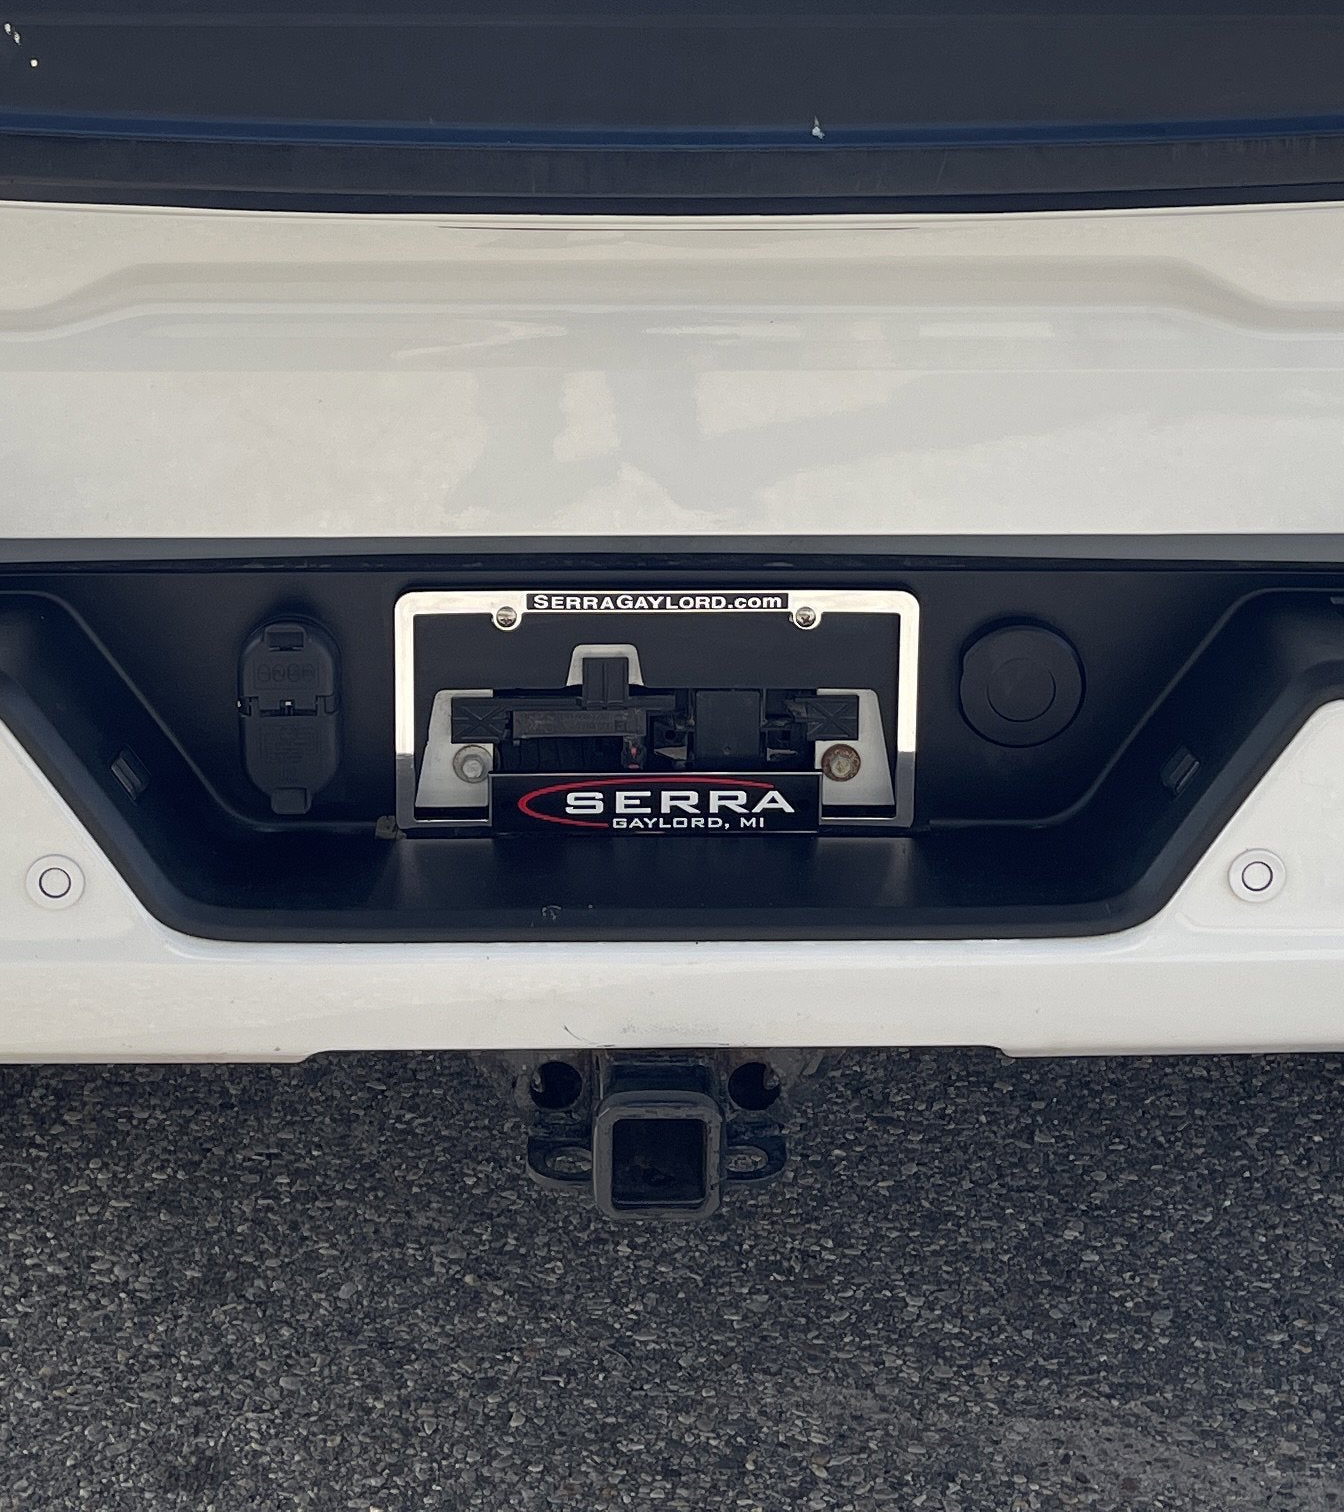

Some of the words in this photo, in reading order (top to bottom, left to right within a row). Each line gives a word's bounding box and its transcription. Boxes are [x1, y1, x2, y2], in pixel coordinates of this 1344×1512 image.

[533, 594, 782, 610] SERRAGAYLORD.com
[565, 790, 795, 814] SERRA
[612, 817, 730, 830] GAYLORD,
[739, 817, 765, 828] MI
